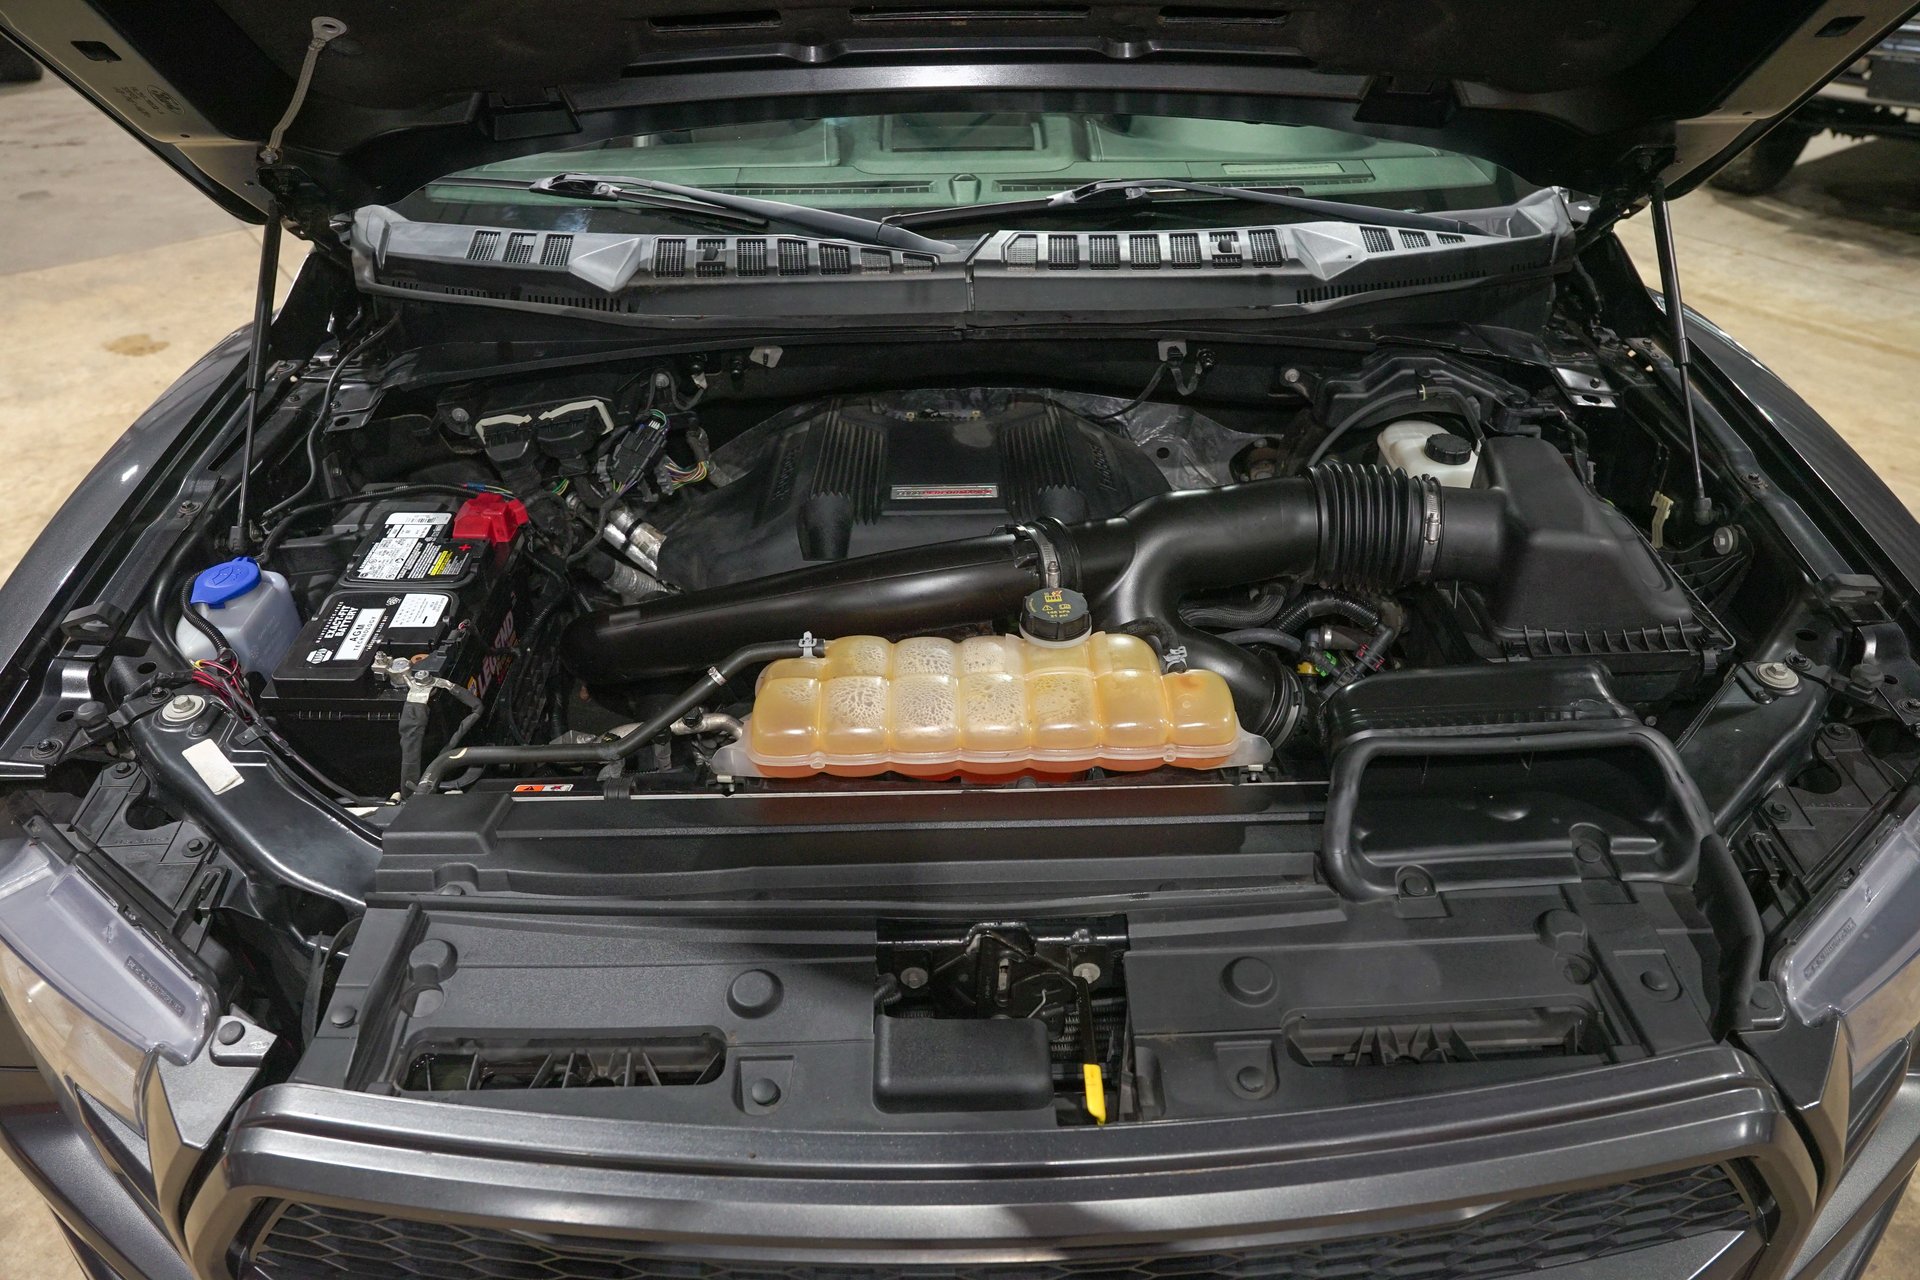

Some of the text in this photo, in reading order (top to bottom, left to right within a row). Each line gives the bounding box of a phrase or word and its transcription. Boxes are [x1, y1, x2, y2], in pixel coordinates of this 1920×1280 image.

[324, 605, 351, 639] EXACT-FIT
[334, 607, 359, 637] BATTERY
[349, 624, 366, 642] AGM
[353, 616, 377, 651] TECHNOLOGY
